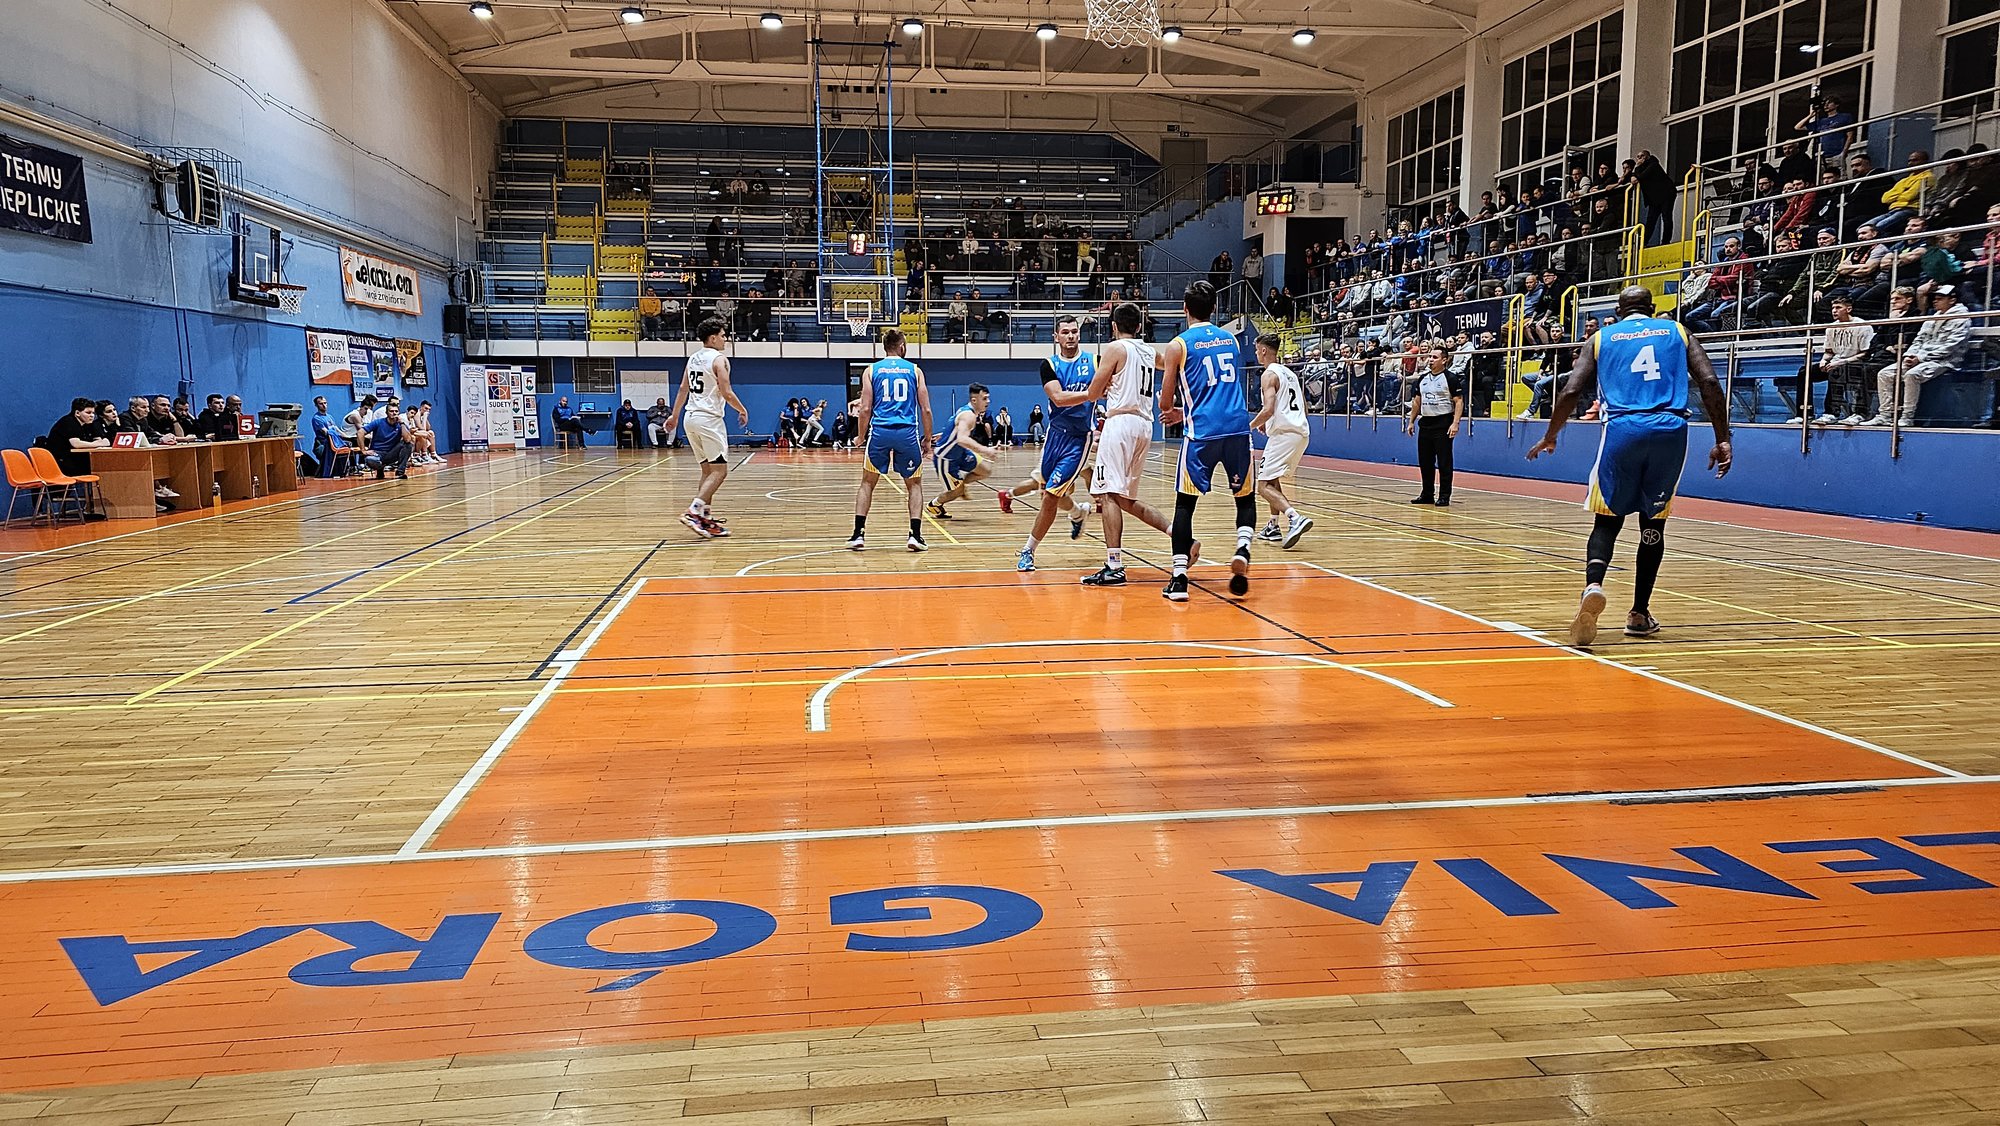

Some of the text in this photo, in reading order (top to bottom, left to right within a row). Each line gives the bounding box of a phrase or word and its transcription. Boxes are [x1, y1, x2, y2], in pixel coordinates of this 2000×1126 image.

[1, 152, 62, 190] TERMY
[0, 186, 82, 226] IEPLICKIE
[1455, 311, 1488, 330] TERMY
[1076, 365, 1089, 377] 12
[1202, 352, 1236, 387] 15
[1630, 344, 1662, 382] 4
[488, 374, 498, 384] KS
[881, 378, 908, 402] 10
[1139, 365, 1152, 398] 11
[1288, 388, 1299, 412] 2
[239, 419, 253, 432] 5
[117, 434, 134, 446] 5
[56, 885, 1044, 1006] GÓRA
